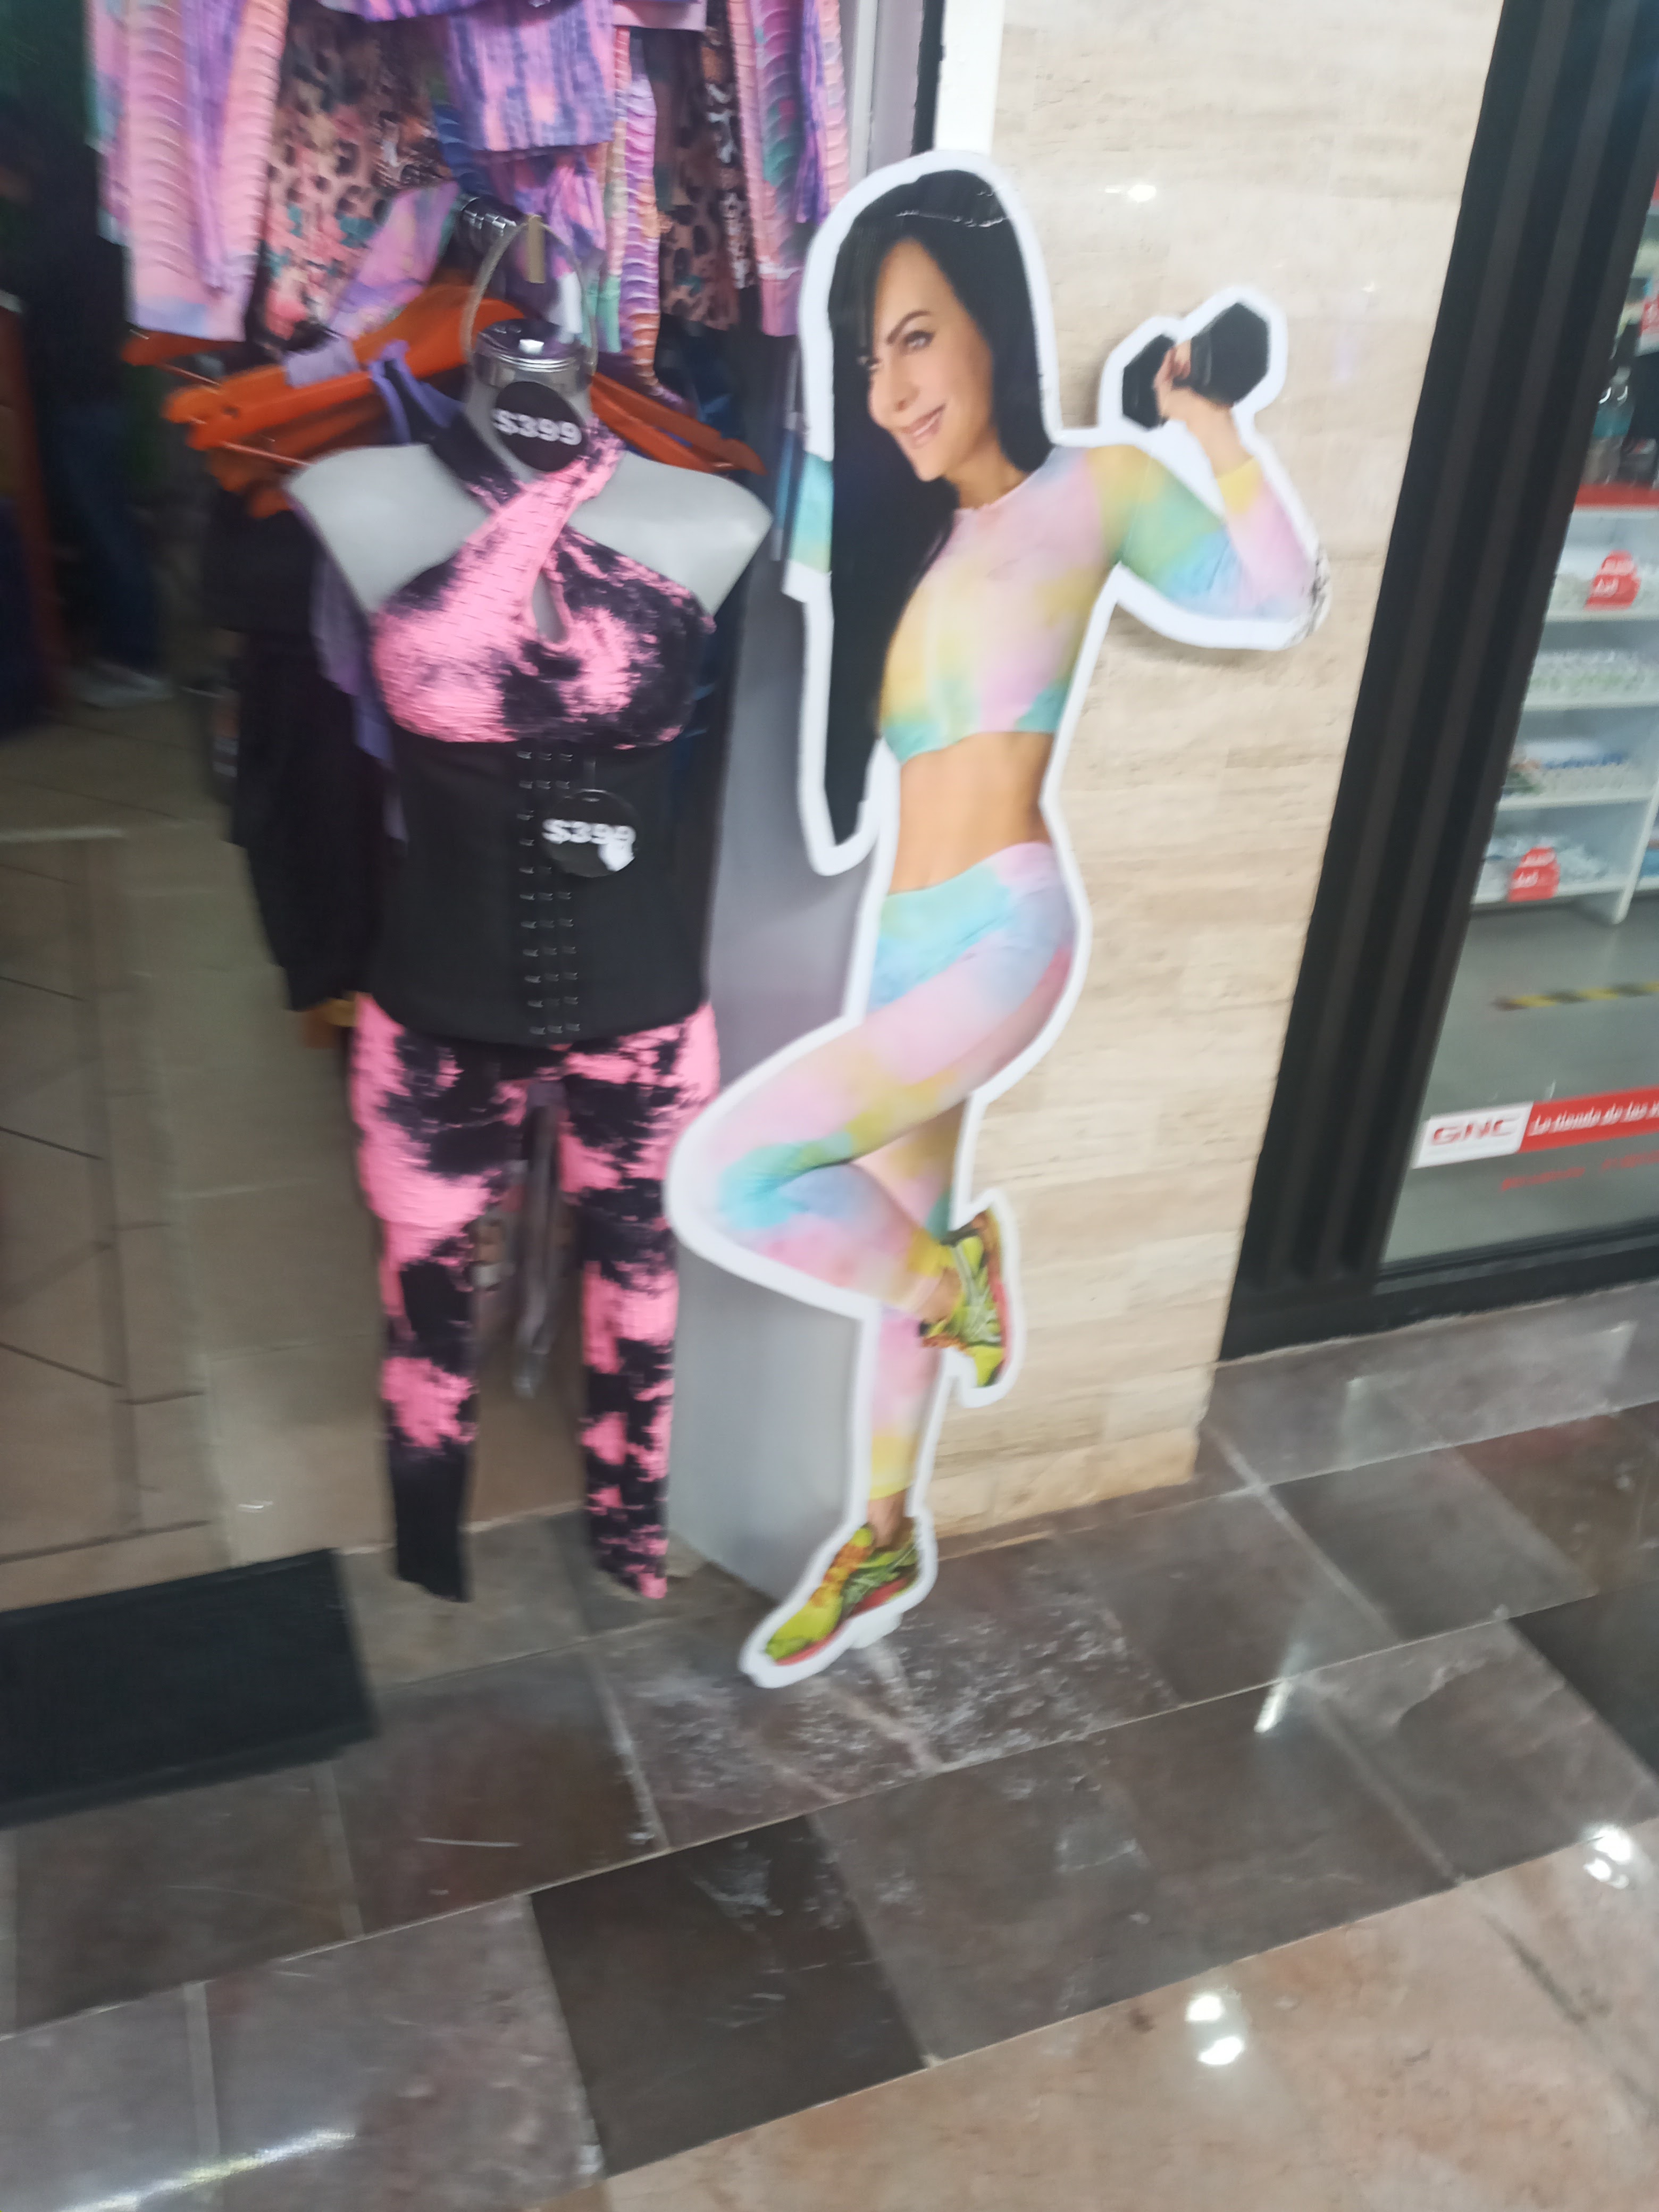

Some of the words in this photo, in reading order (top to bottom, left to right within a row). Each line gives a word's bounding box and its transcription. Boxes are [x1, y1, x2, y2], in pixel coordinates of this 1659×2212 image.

[491, 408, 582, 446] $399
[542, 818, 636, 844] $399
[1432, 1119, 1519, 1145] GNC
